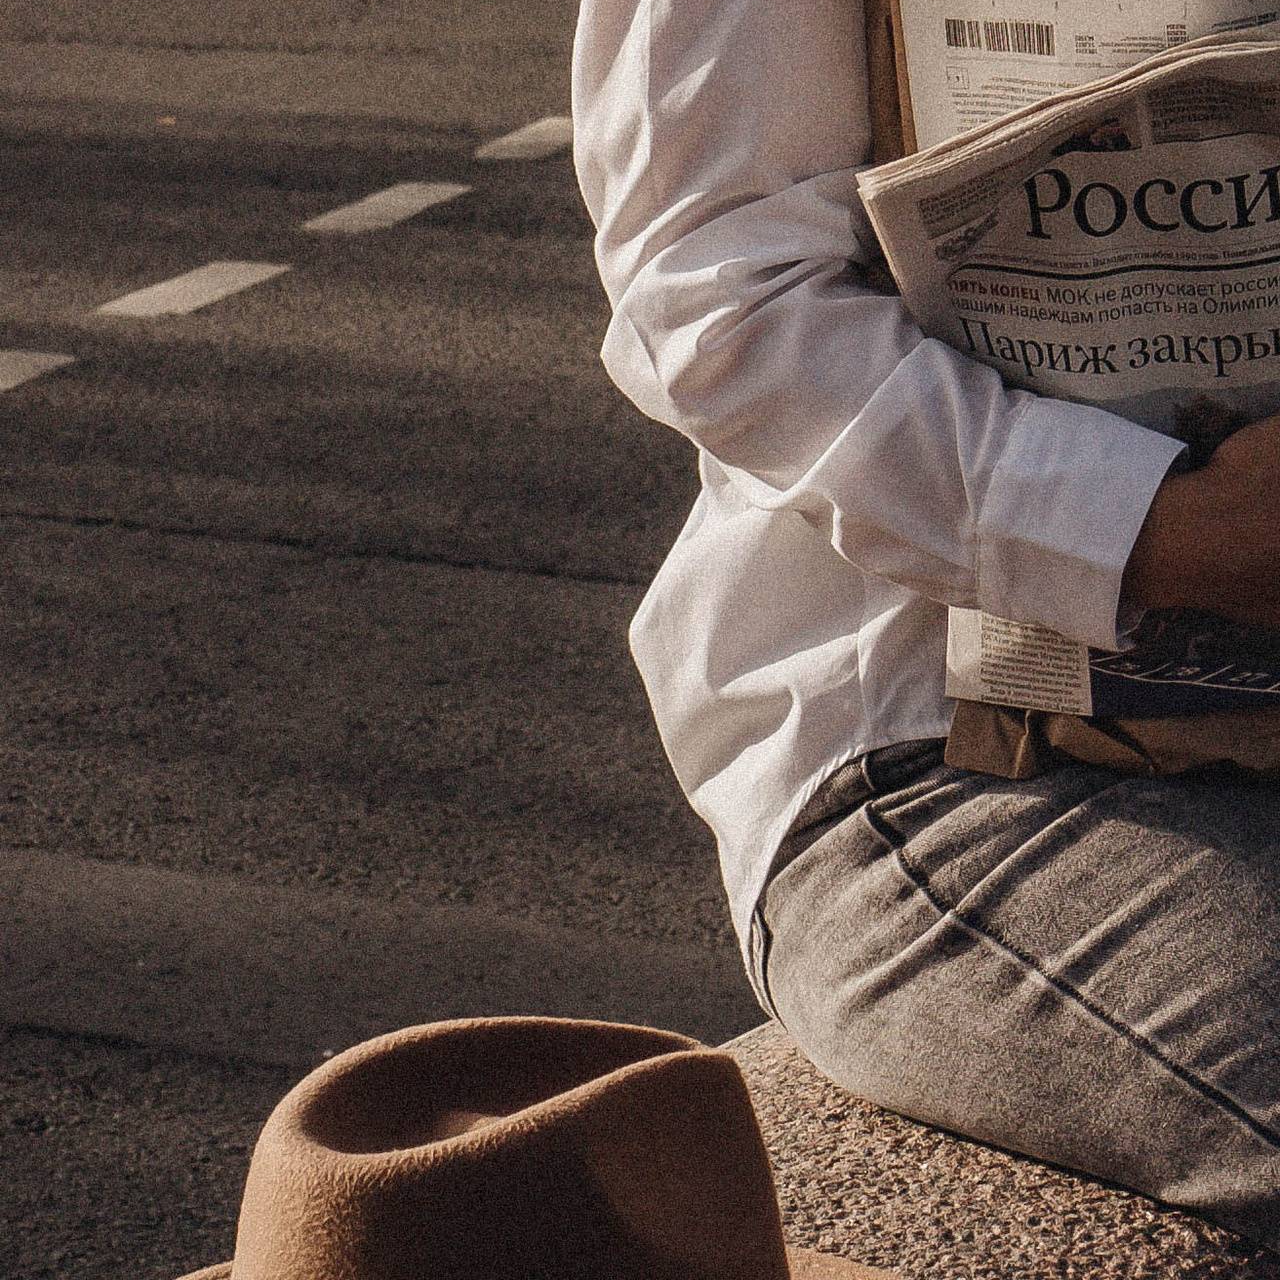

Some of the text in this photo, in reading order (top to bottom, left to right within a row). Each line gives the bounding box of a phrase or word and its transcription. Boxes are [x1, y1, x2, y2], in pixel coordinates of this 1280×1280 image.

[1046, 286, 1091, 305] МОК
[1095, 288, 1117, 304] не
[1120, 282, 1217, 301] допускает
[1010, 303, 1094, 324] надеждам
[1098, 296, 1173, 323] попасть
[1177, 296, 1198, 315] на
[958, 316, 1121, 378] Париж
